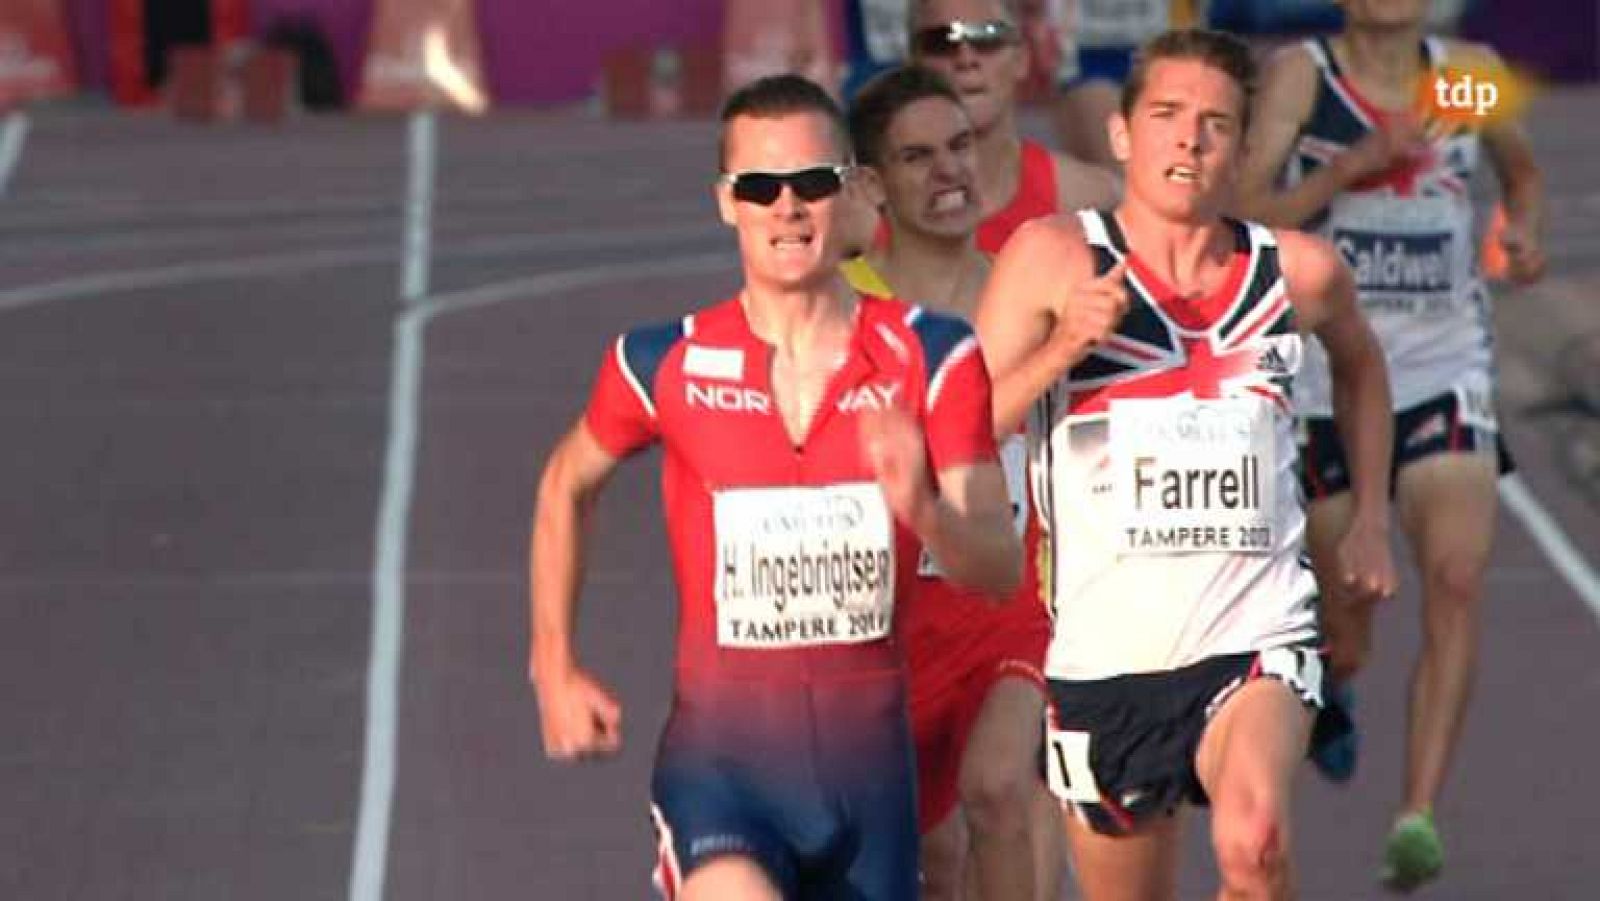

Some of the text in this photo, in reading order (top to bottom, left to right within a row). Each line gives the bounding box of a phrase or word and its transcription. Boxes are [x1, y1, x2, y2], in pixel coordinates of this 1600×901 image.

[1134, 455, 1259, 509] Farrell
[1126, 526, 1231, 548] TAMPERE
[723, 539, 891, 613] H. Ingebrigtsen
[731, 617, 837, 642] TAMPERE
[1052, 741, 1072, 789] 1
